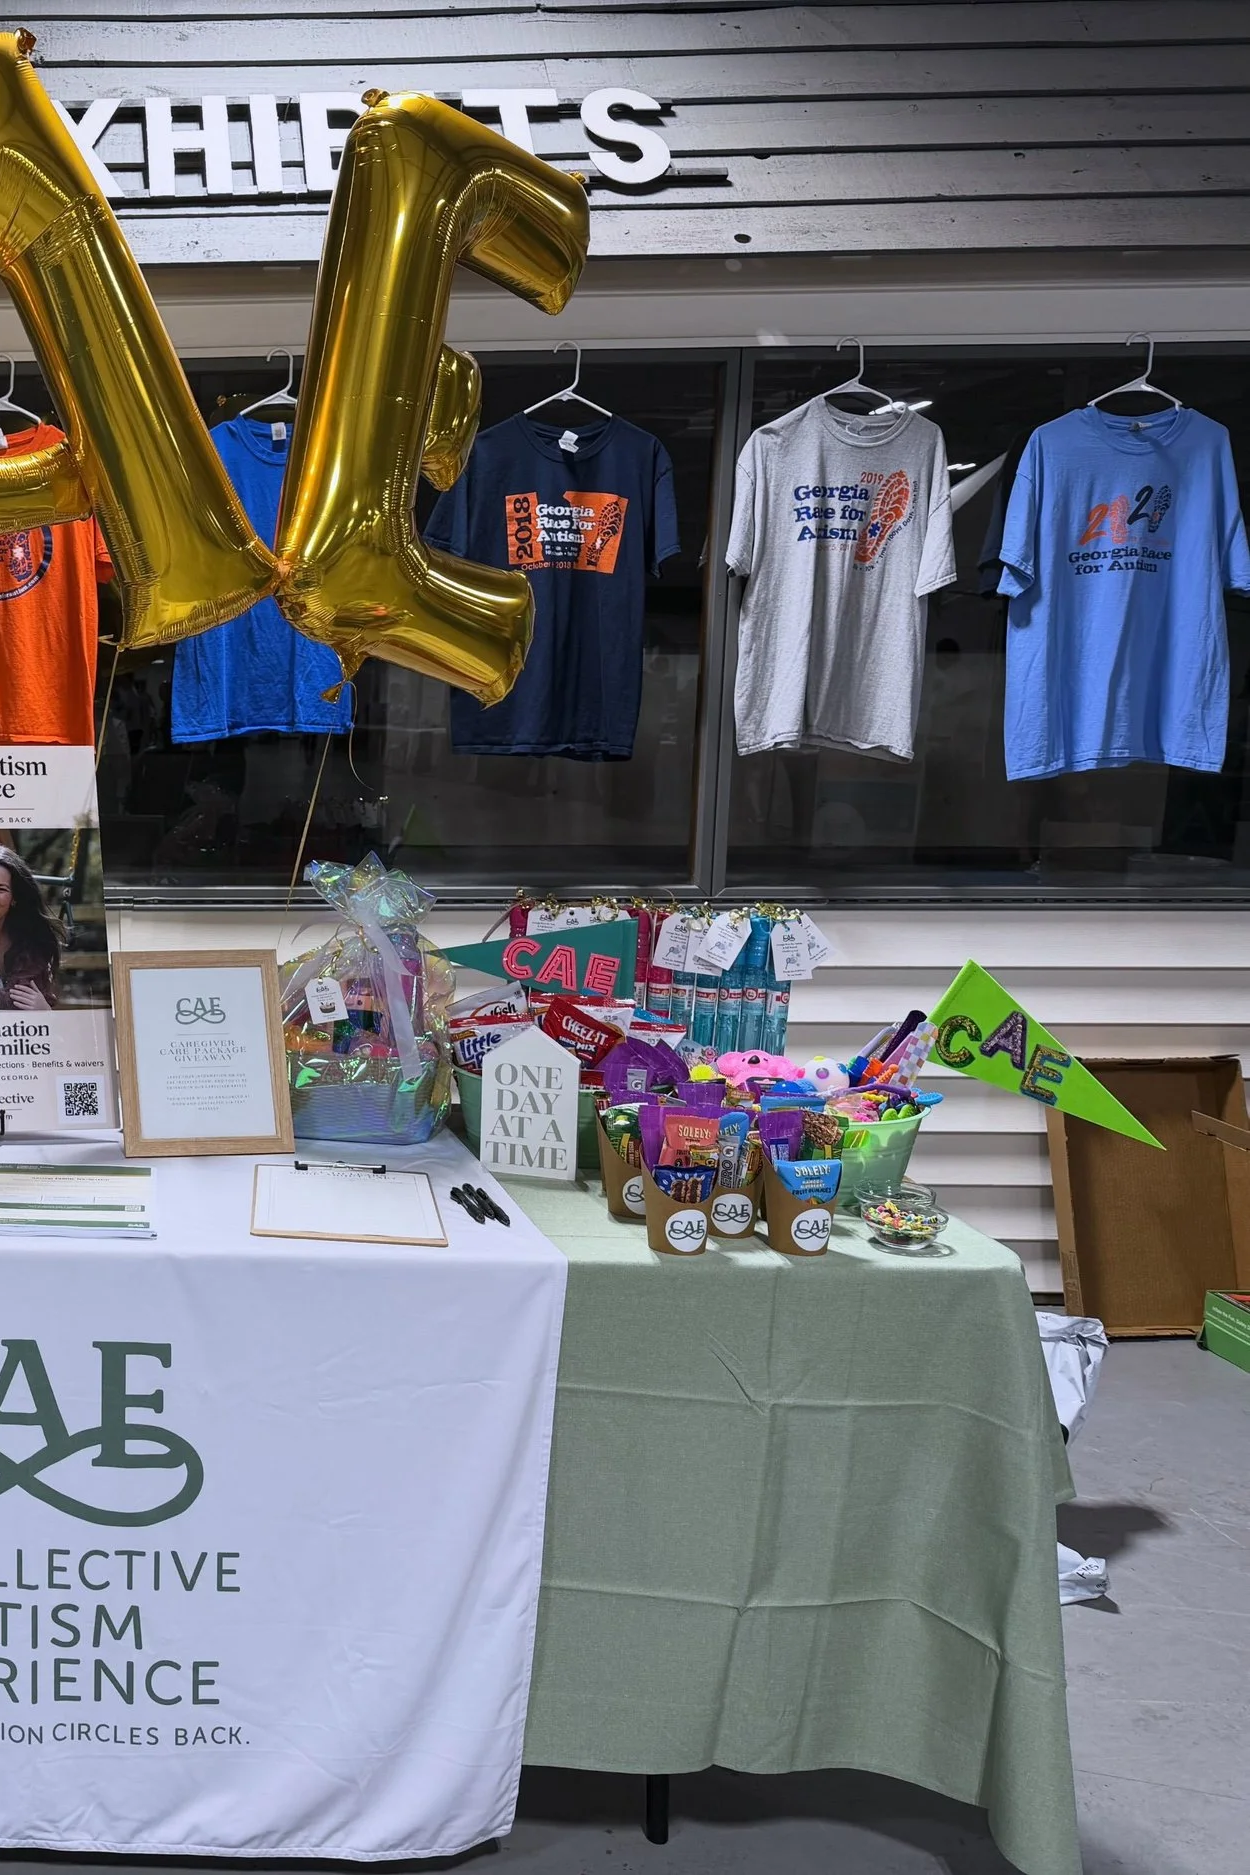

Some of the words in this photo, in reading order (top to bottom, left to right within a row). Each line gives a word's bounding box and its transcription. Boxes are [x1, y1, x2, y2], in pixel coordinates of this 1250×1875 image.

[861, 471, 884, 485] 2019
[535, 504, 595, 518] Georgia
[840, 505, 866, 521] for
[514, 497, 533, 559] 2018
[535, 517, 570, 530] Race
[572, 518, 596, 530] For
[536, 530, 586, 544] Autism
[1069, 546, 1139, 563] Georgia
[1141, 547, 1172, 560] Race
[1075, 563, 1103, 575] for
[502, 937, 620, 996] CAE
[176, 997, 221, 1017] CAE
[159, 1048, 190, 1056] CARE
[194, 1046, 247, 1055] PACKAGE
[170, 1039, 236, 1048] CAREGIVER
[460, 1032, 502, 1062] Little
[576, 1042, 596, 1053] MIX
[32, 1060, 64, 1068] Benefits
[66, 1060, 72, 1068] &
[174, 1054, 233, 1062] GIVEAWAY
[935, 1010, 1072, 1107] CAE
[495, 1063, 563, 1090] ONE
[631, 1080, 643, 1090] G
[495, 1088, 560, 1115] DAY
[490, 1114, 532, 1138] AT
[542, 1119, 565, 1142] A
[486, 1141, 568, 1171] TIME
[723, 1146, 735, 1157] G
[714, 1203, 749, 1218] CAE
[670, 1219, 704, 1234] CAE
[797, 1218, 829, 1234] CAE
[52, 1722, 160, 1746] CIRCLES
[174, 1725, 251, 1747] BACK.
